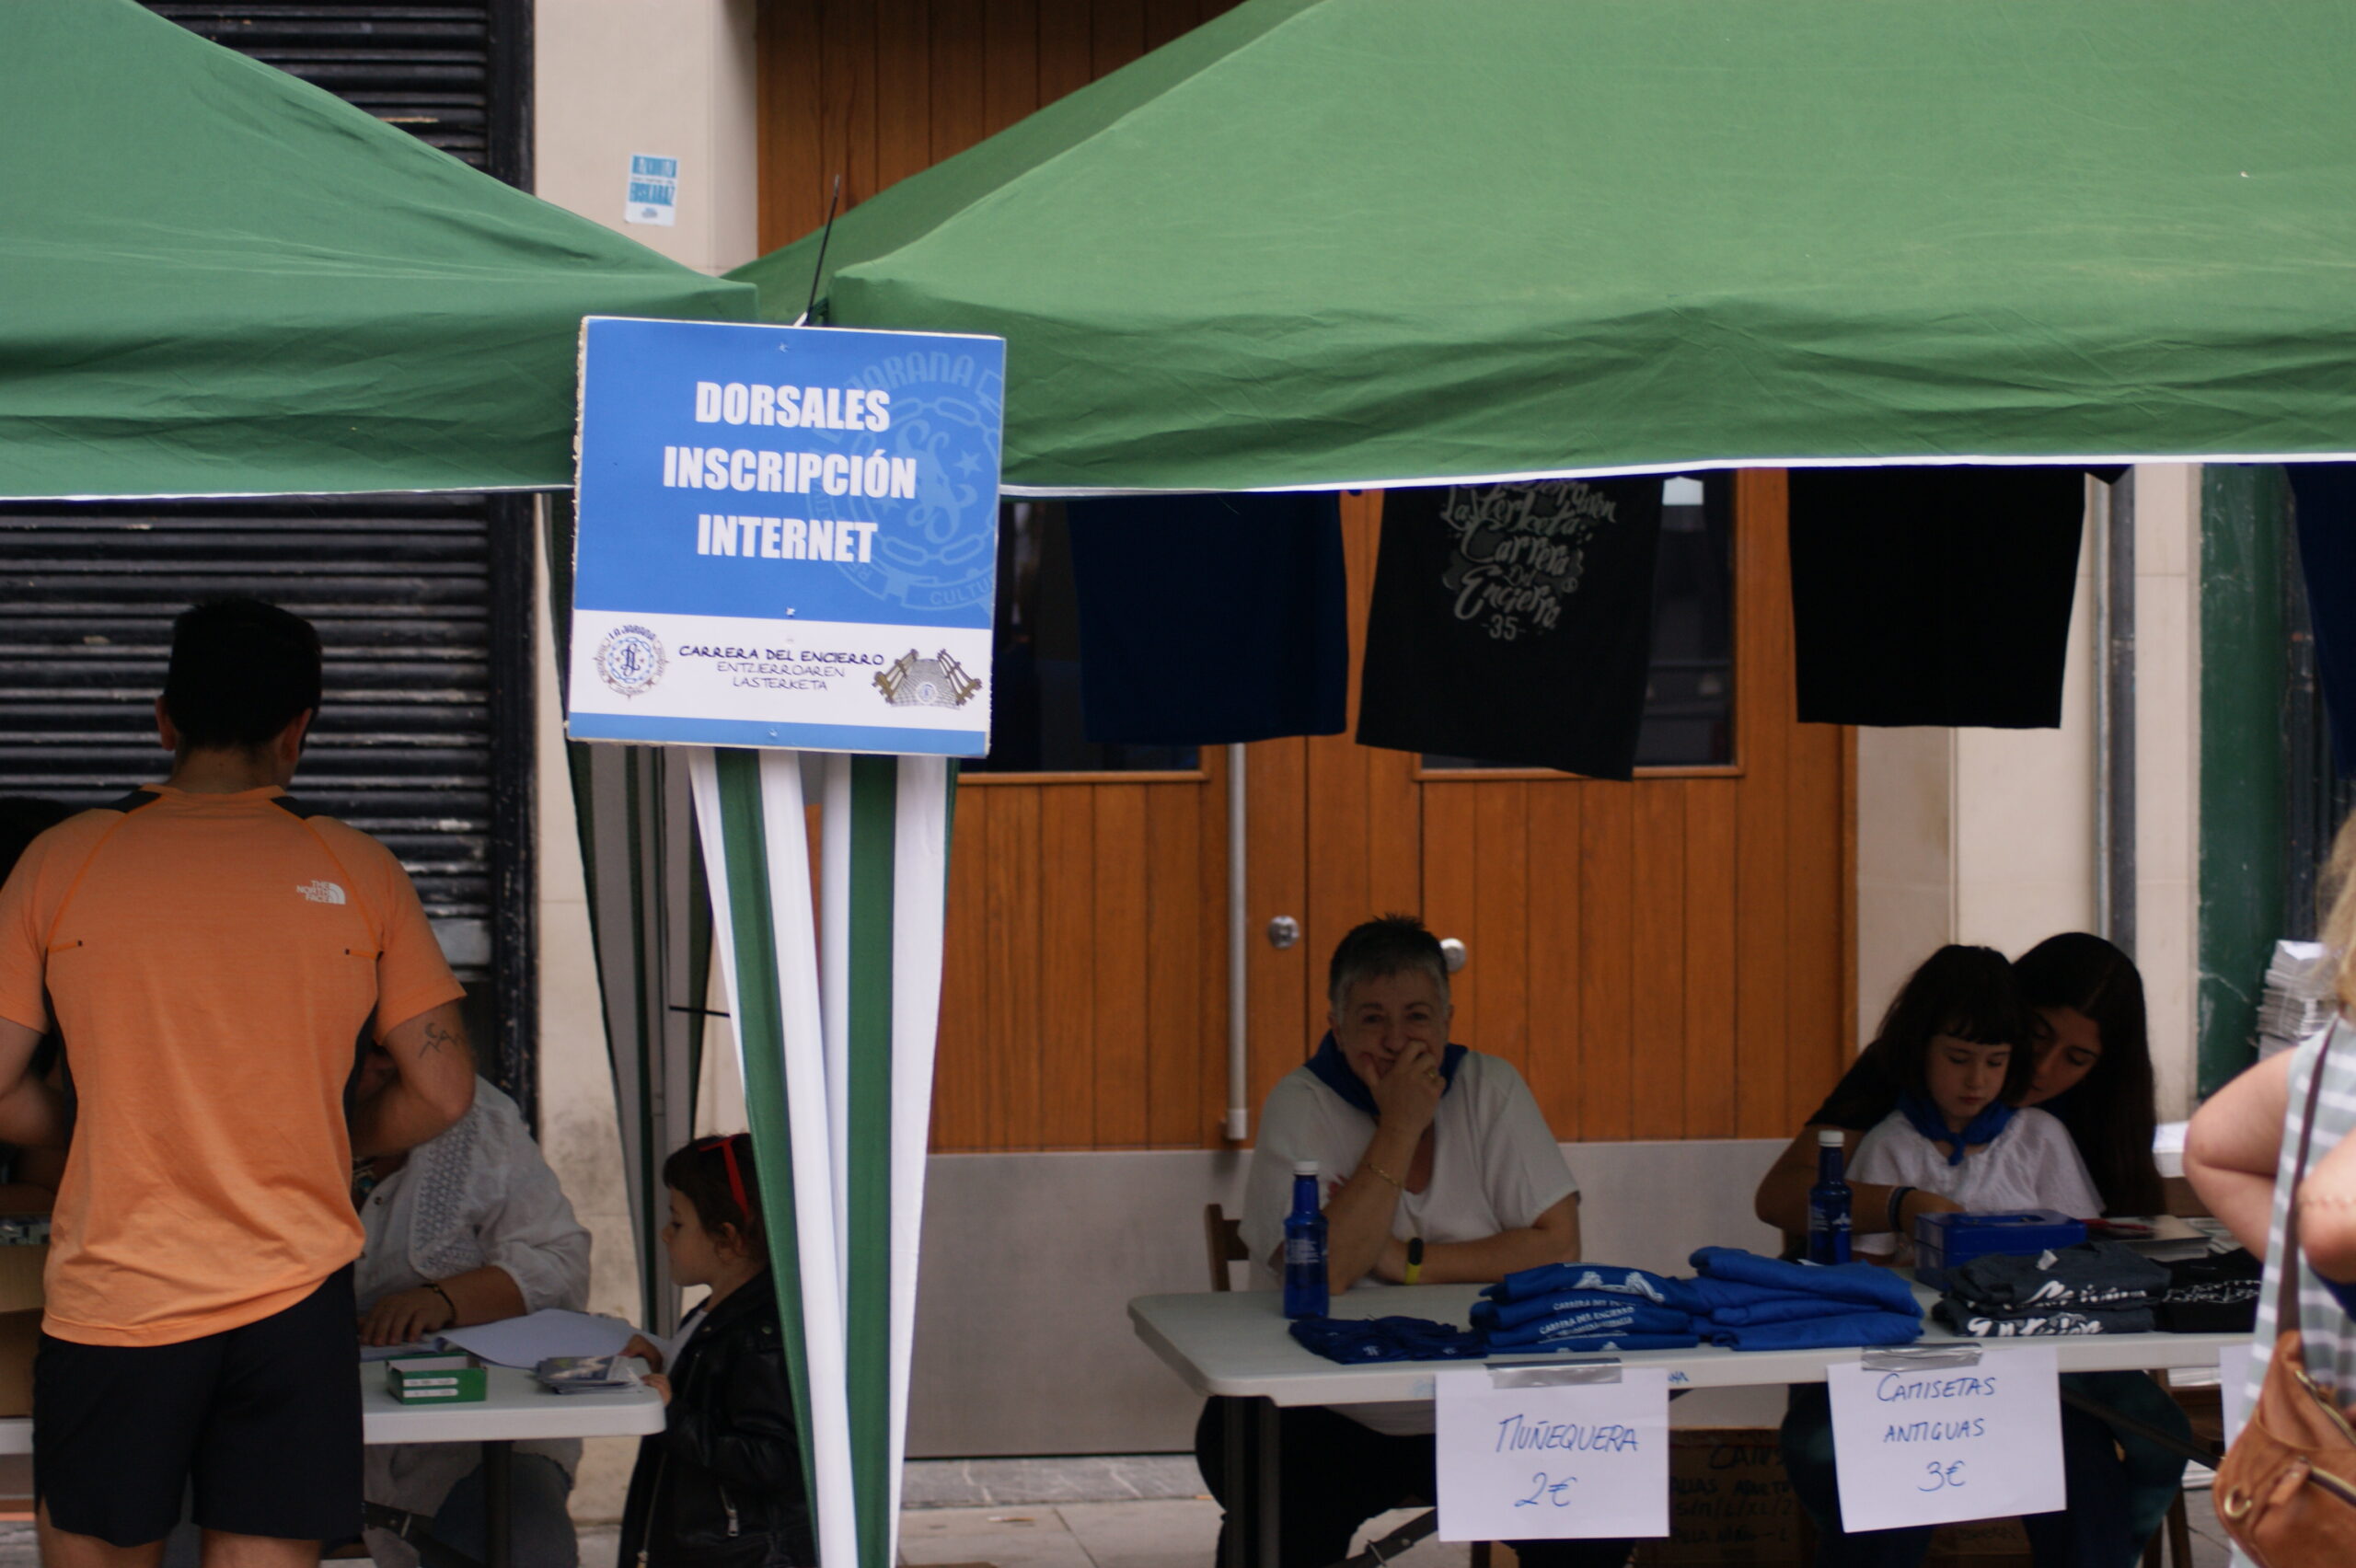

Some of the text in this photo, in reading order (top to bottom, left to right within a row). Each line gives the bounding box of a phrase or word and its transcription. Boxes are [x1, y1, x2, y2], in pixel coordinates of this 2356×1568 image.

[695, 381, 891, 432] DORSALES
[663, 446, 917, 499] INSCRIPCIÓN
[697, 514, 878, 563] INTERNET
[1461, 519, 1570, 576] Carrera
[678, 645, 884, 665] CARRERA DEL ENCIERRO
[716, 661, 846, 677] ENTZIERROAREN
[733, 676, 829, 691] LASTERKETA
[1877, 1373, 1996, 1402] CAMISETAS
[1496, 1413, 1640, 1452] MUÑEQUERA
[1883, 1418, 1985, 1443] ANTIGUAS
[1514, 1472, 1577, 1507] 2€
[1917, 1459, 1966, 1492] 3€
